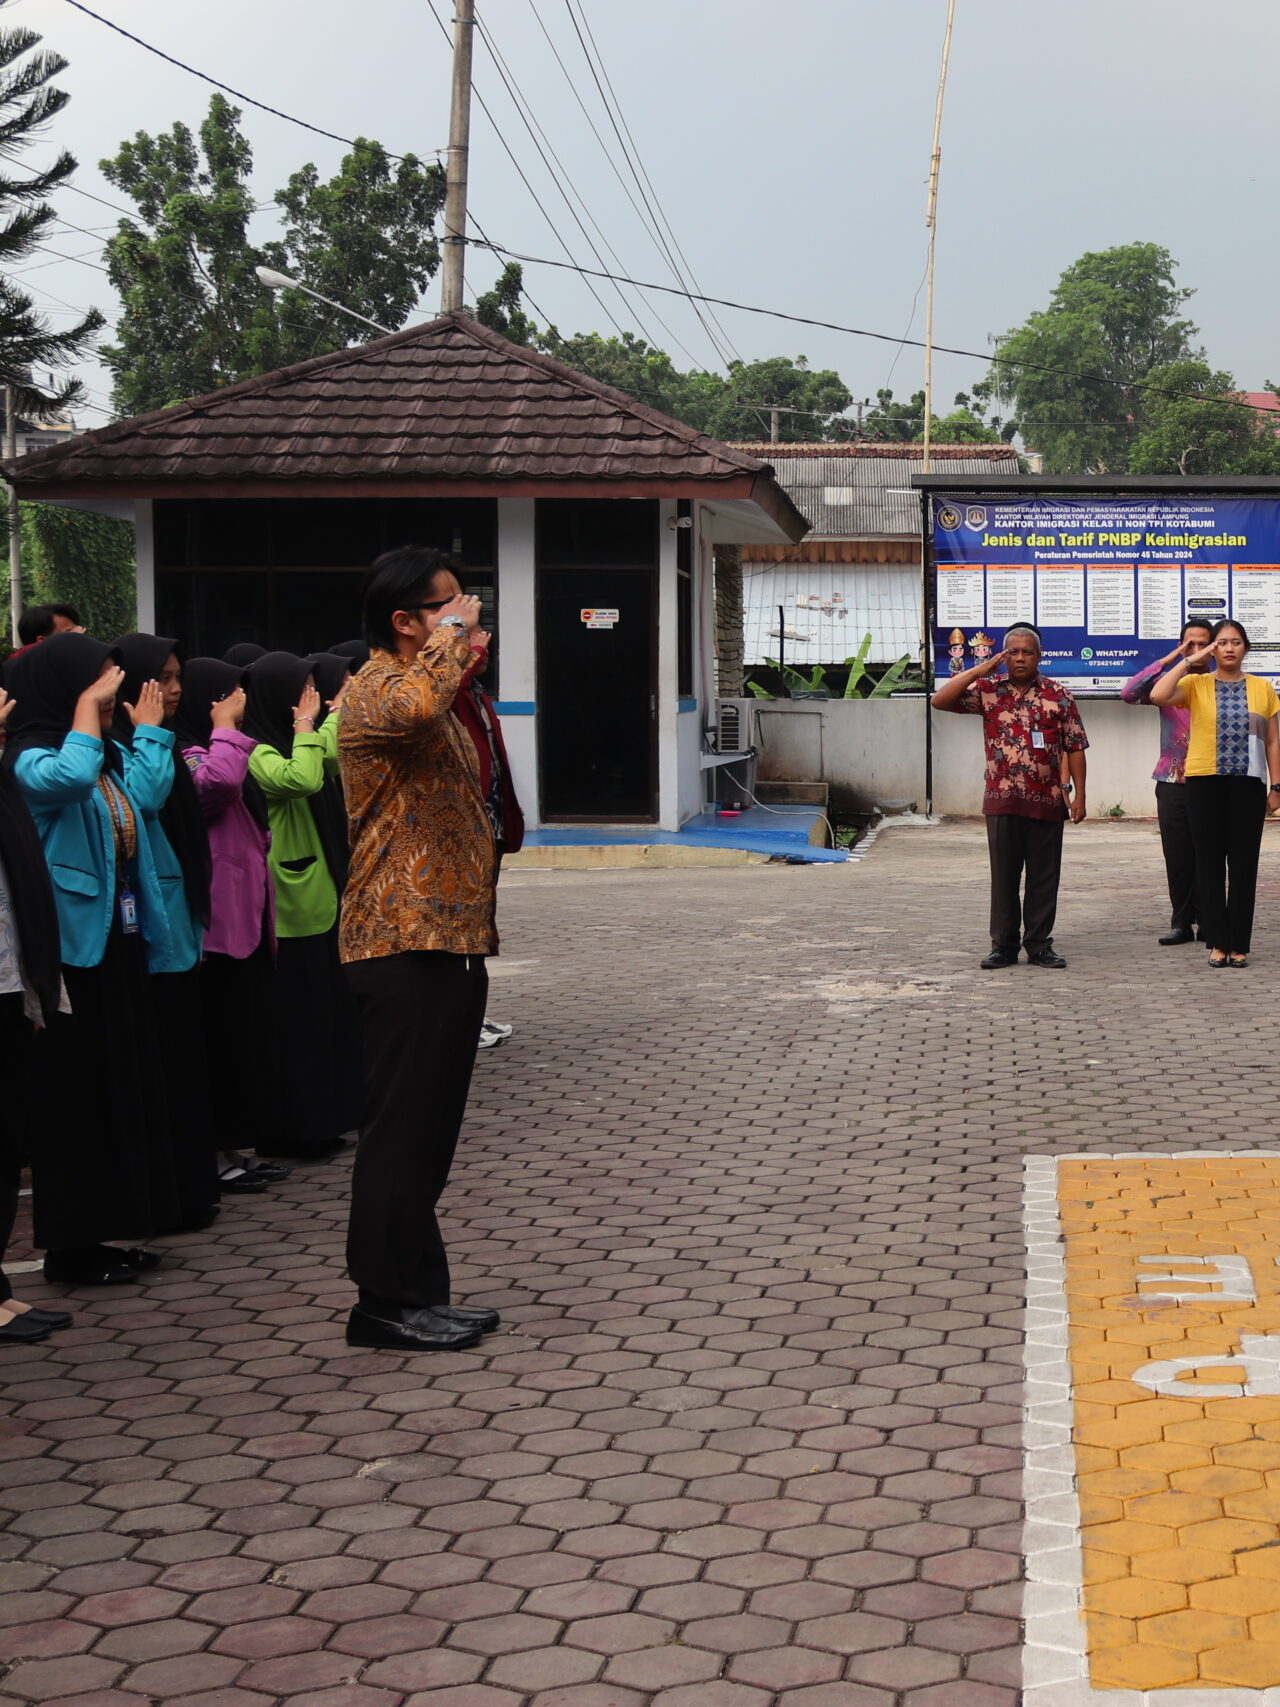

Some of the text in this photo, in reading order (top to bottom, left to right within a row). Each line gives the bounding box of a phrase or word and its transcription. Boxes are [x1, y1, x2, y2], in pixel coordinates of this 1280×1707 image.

[994, 520, 1215, 528] KANTOR IMIGRASI KELAS II NON TPI KOTABUMI
[981, 532, 1247, 549] Jenis dan Tarif PNBP Keimigrasian
[1034, 551, 1193, 559] Peraturan Pemerintah Nomor 45 Tahun 2024
